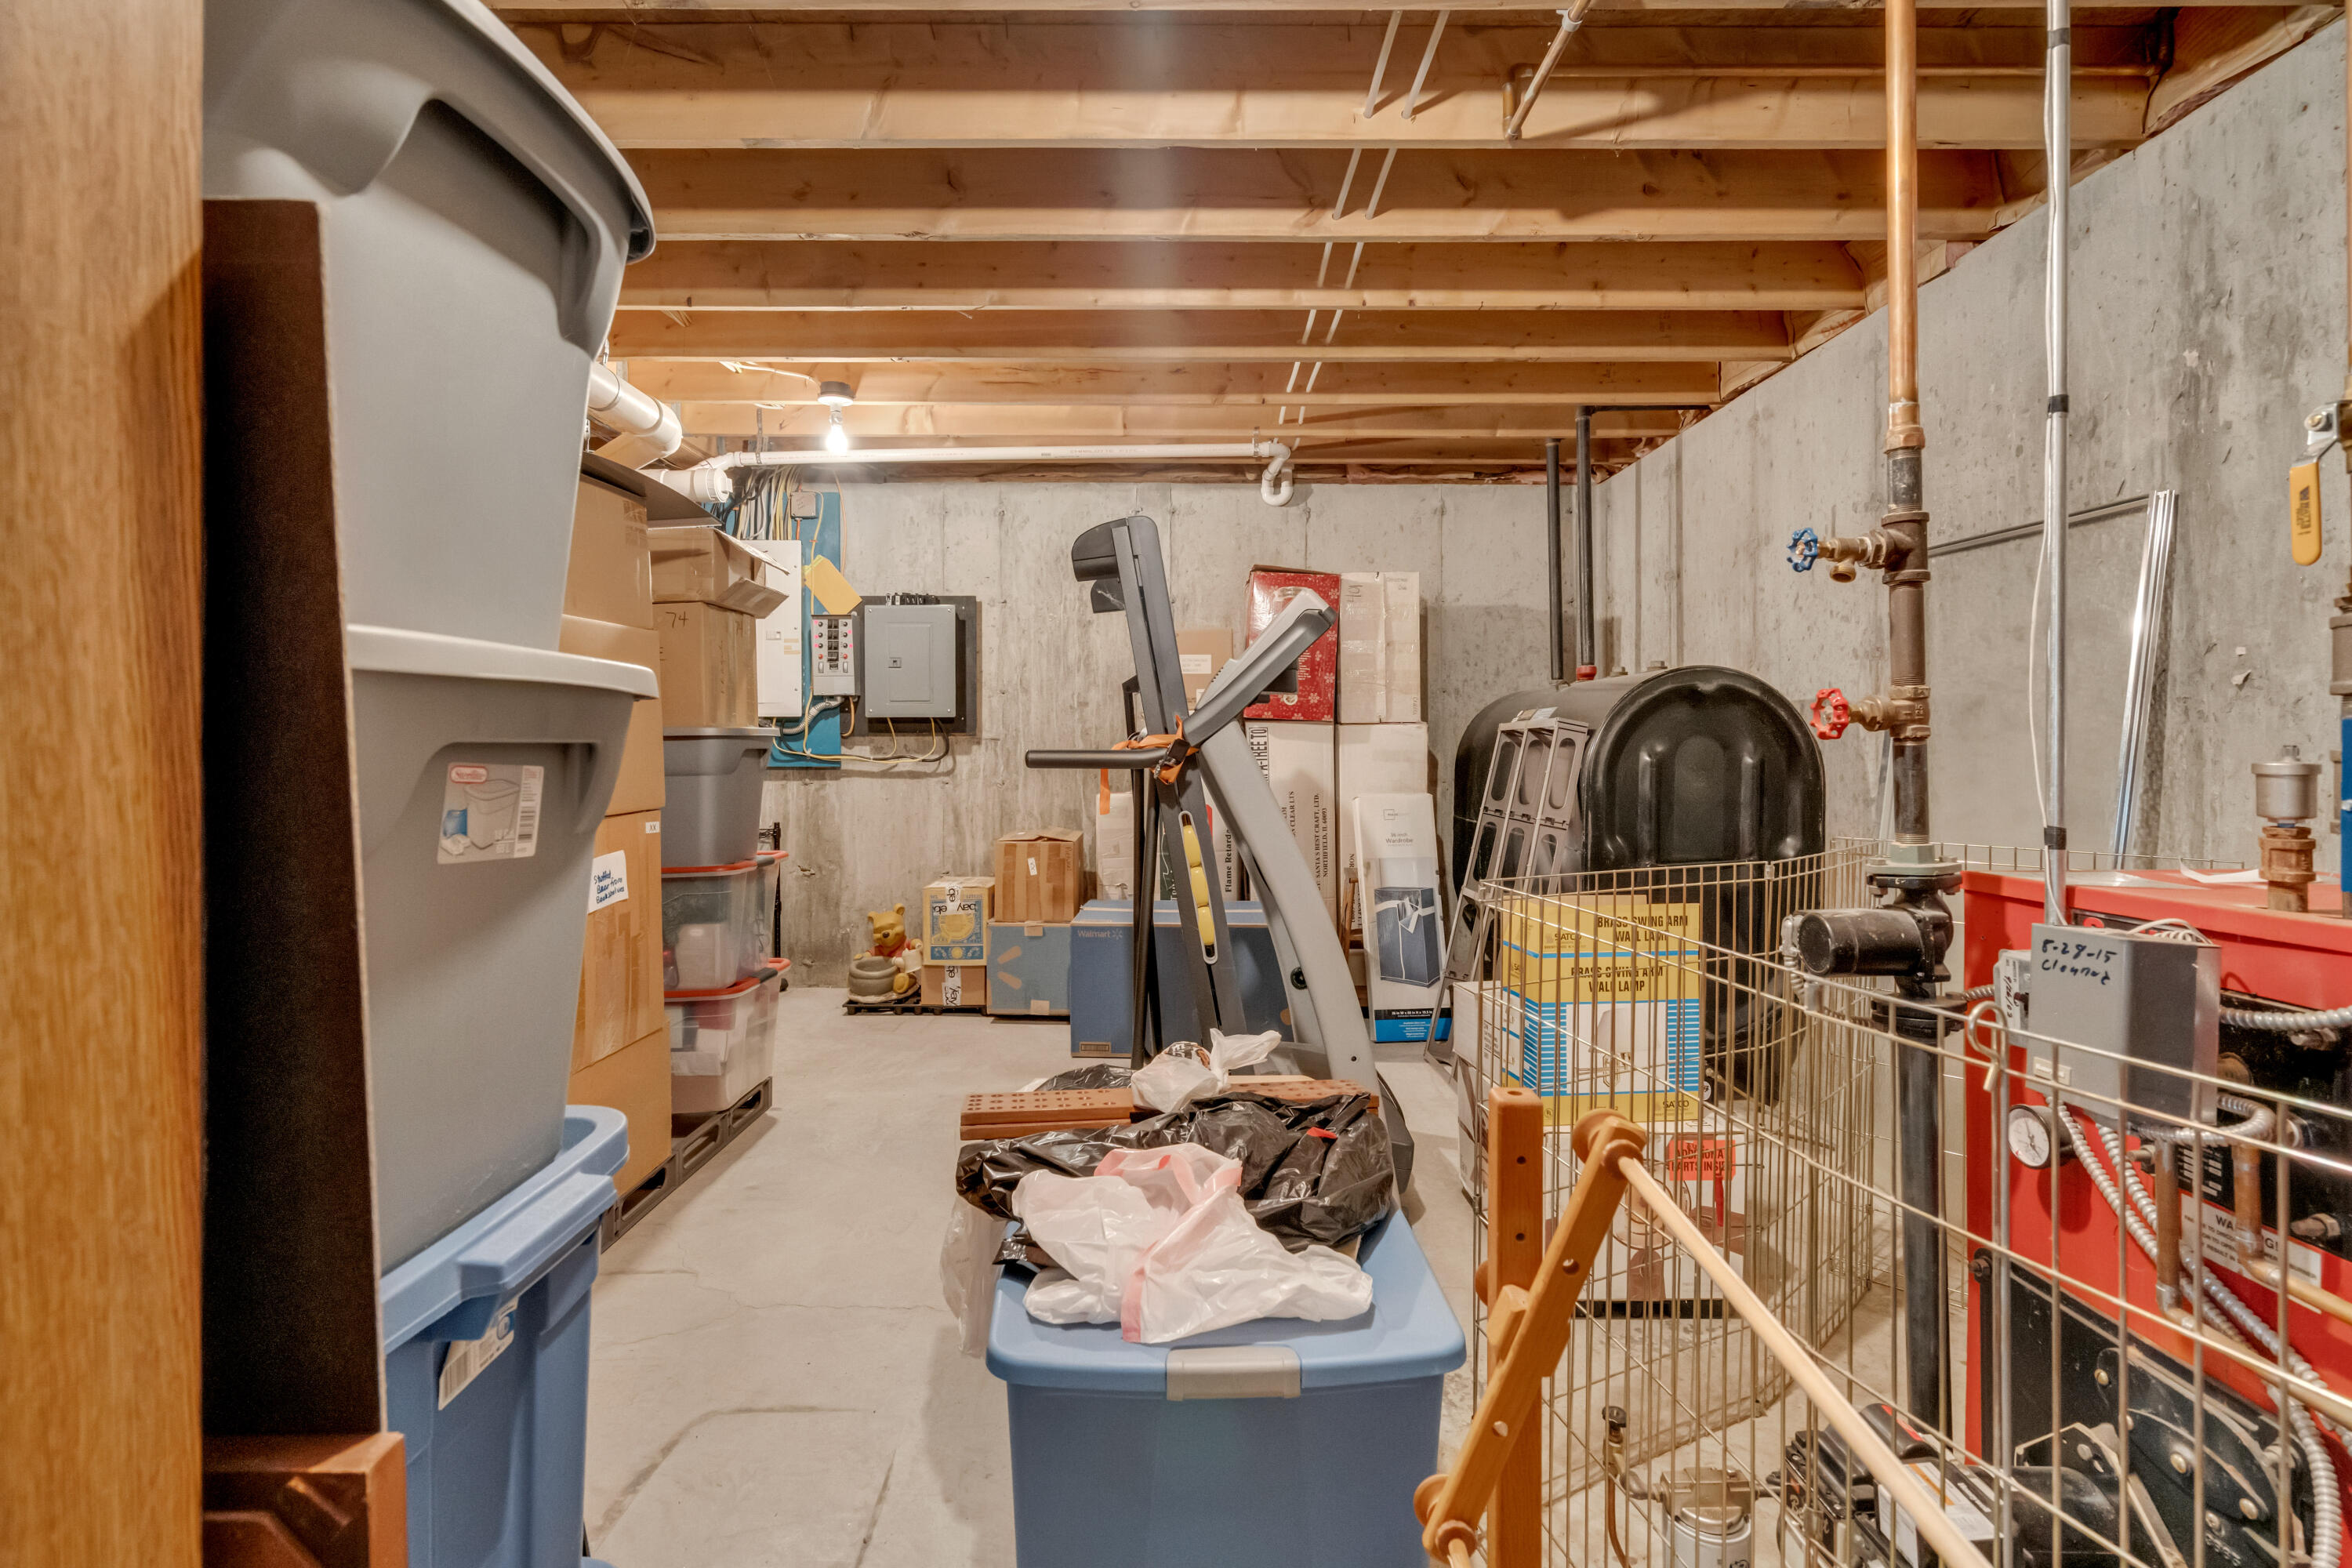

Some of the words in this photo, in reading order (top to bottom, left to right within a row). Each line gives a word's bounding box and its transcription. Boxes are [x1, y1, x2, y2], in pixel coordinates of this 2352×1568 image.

[665, 611, 689, 628] 74
[1668, 916, 1688, 927] ARM
[1616, 931, 1640, 942] WAL
[1676, 1149, 1725, 1160] ADDIIONA
